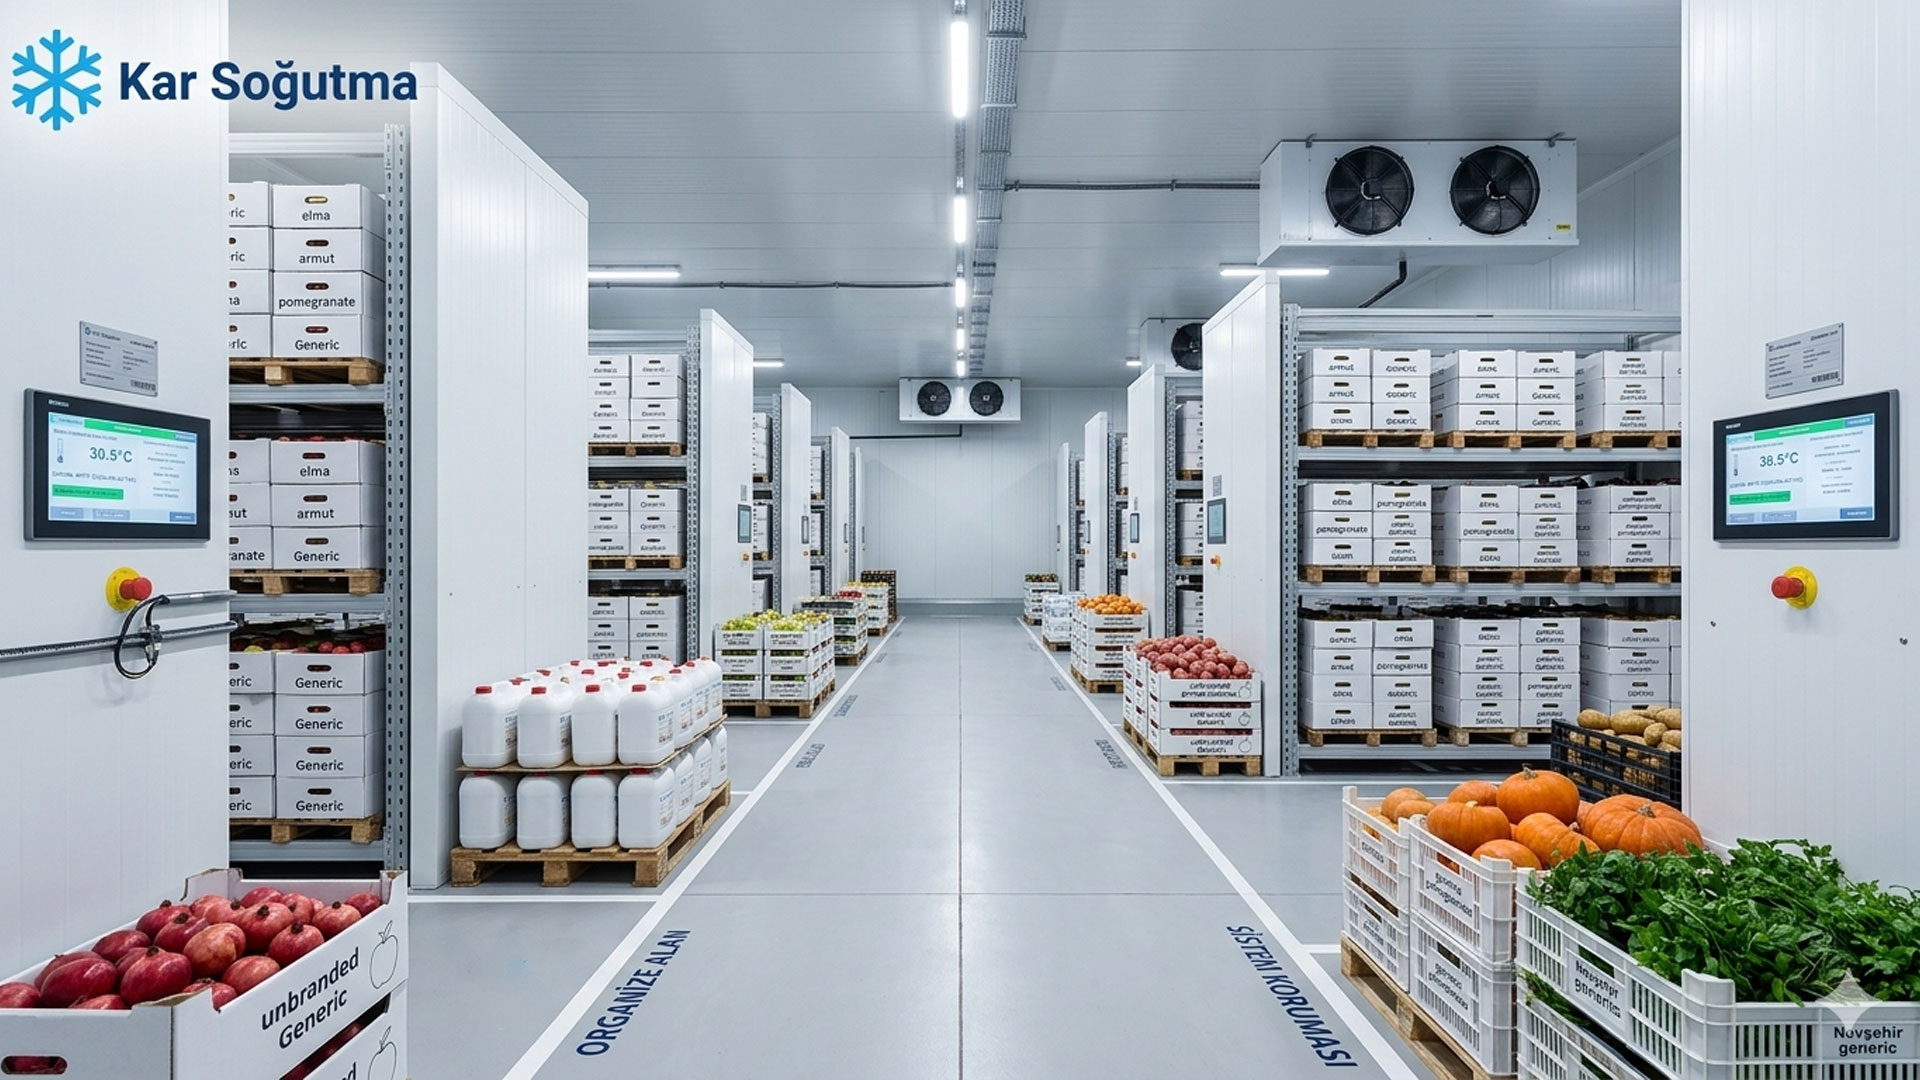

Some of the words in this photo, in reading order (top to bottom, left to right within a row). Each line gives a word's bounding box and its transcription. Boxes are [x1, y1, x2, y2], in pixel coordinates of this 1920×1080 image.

[301, 209, 331, 222] elma
[298, 253, 335, 264] armut
[278, 297, 356, 310] pomegranate
[294, 339, 340, 351] Generic
[89, 446, 133, 464] 30.5°C
[299, 465, 330, 478] elma
[296, 508, 335, 520] armut
[293, 550, 340, 562] Generic
[294, 677, 343, 689] Generic
[295, 718, 344, 730] Generic
[295, 759, 344, 772] Generic
[295, 799, 344, 812] Generic
[262, 946, 359, 1031] unbranded
[576, 968, 664, 1056] ORGANİZE
[644, 930, 691, 966] ALAN
[279, 989, 348, 1049] Generic
[1261, 975, 1358, 1067] KORUMASI
[1838, 1041, 1898, 1057] generic
